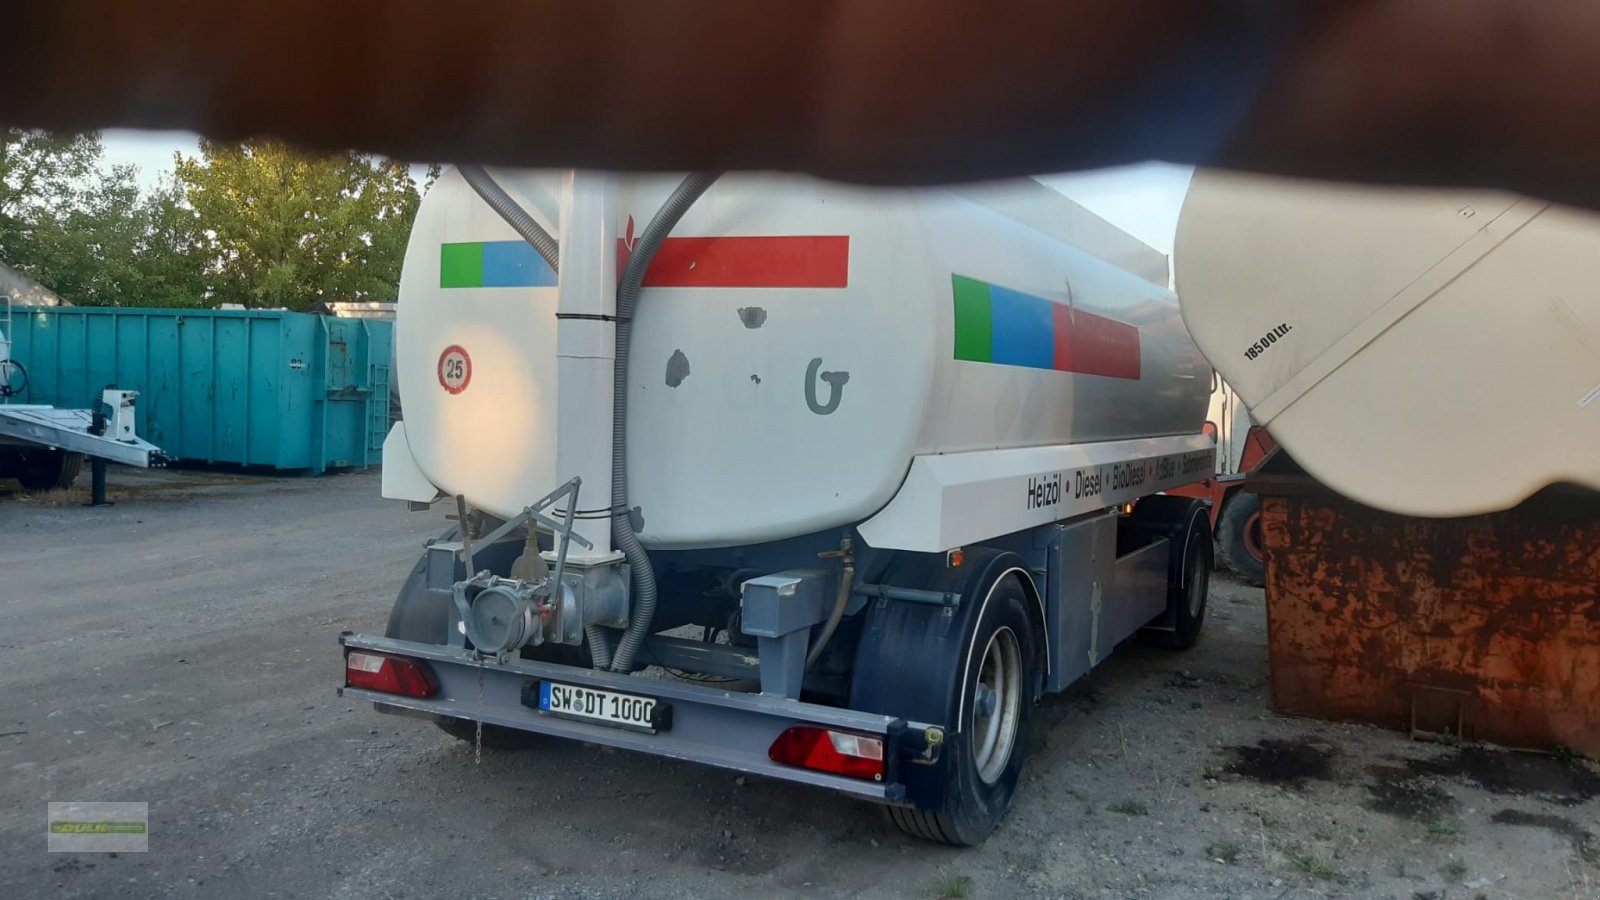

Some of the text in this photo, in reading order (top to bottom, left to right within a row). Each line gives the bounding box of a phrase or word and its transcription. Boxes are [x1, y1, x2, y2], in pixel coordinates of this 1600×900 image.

[446, 358, 463, 379] 25
[1027, 473, 1062, 510] Heizöl
[1074, 467, 1102, 499] Diesel
[1112, 460, 1146, 490] BioDiesel
[551, 686, 572, 711] SW
[585, 692, 607, 716] DT
